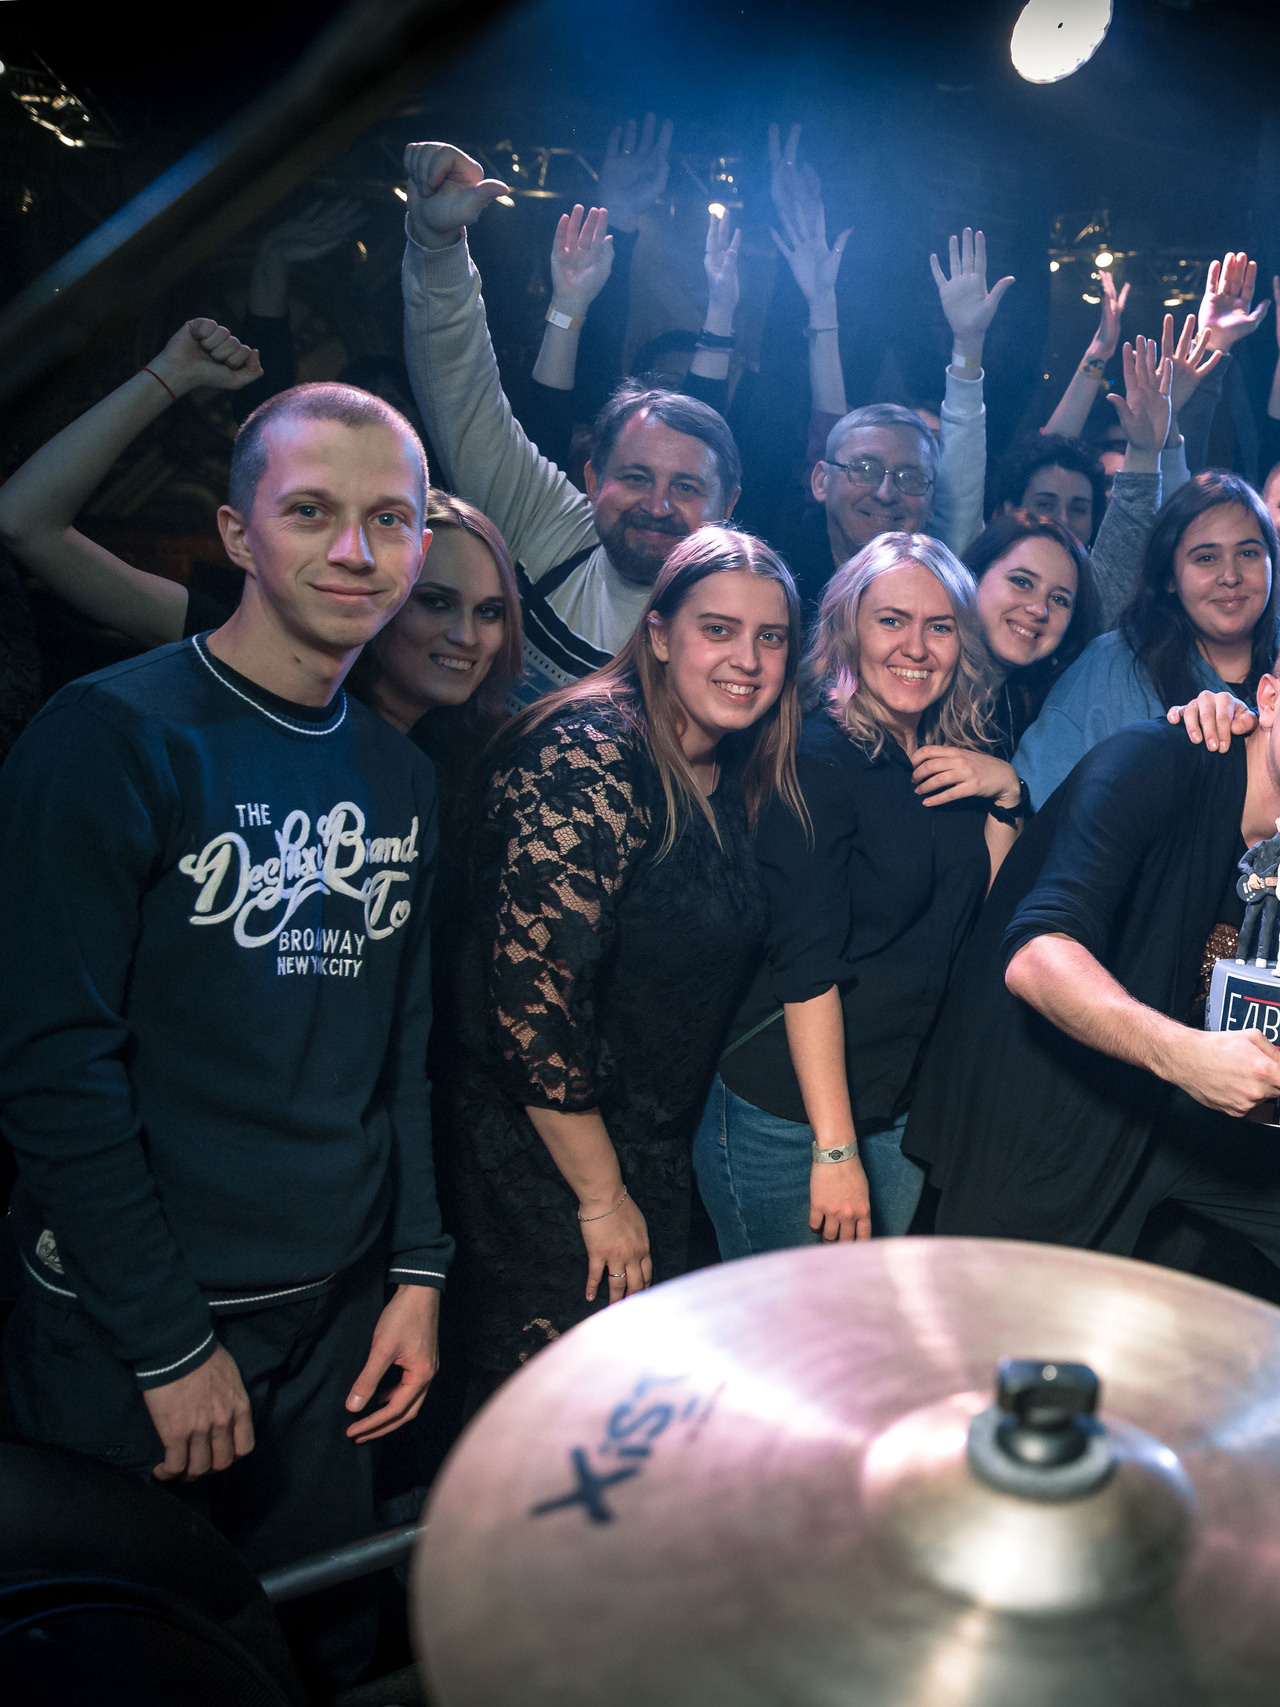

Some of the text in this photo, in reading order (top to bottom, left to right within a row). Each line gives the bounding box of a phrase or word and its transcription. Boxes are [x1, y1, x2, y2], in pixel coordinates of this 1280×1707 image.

[235, 803, 273, 828] THE
[278, 928, 366, 956] BROWAY
[277, 955, 310, 975] NEW
[329, 958, 363, 978] CITY
